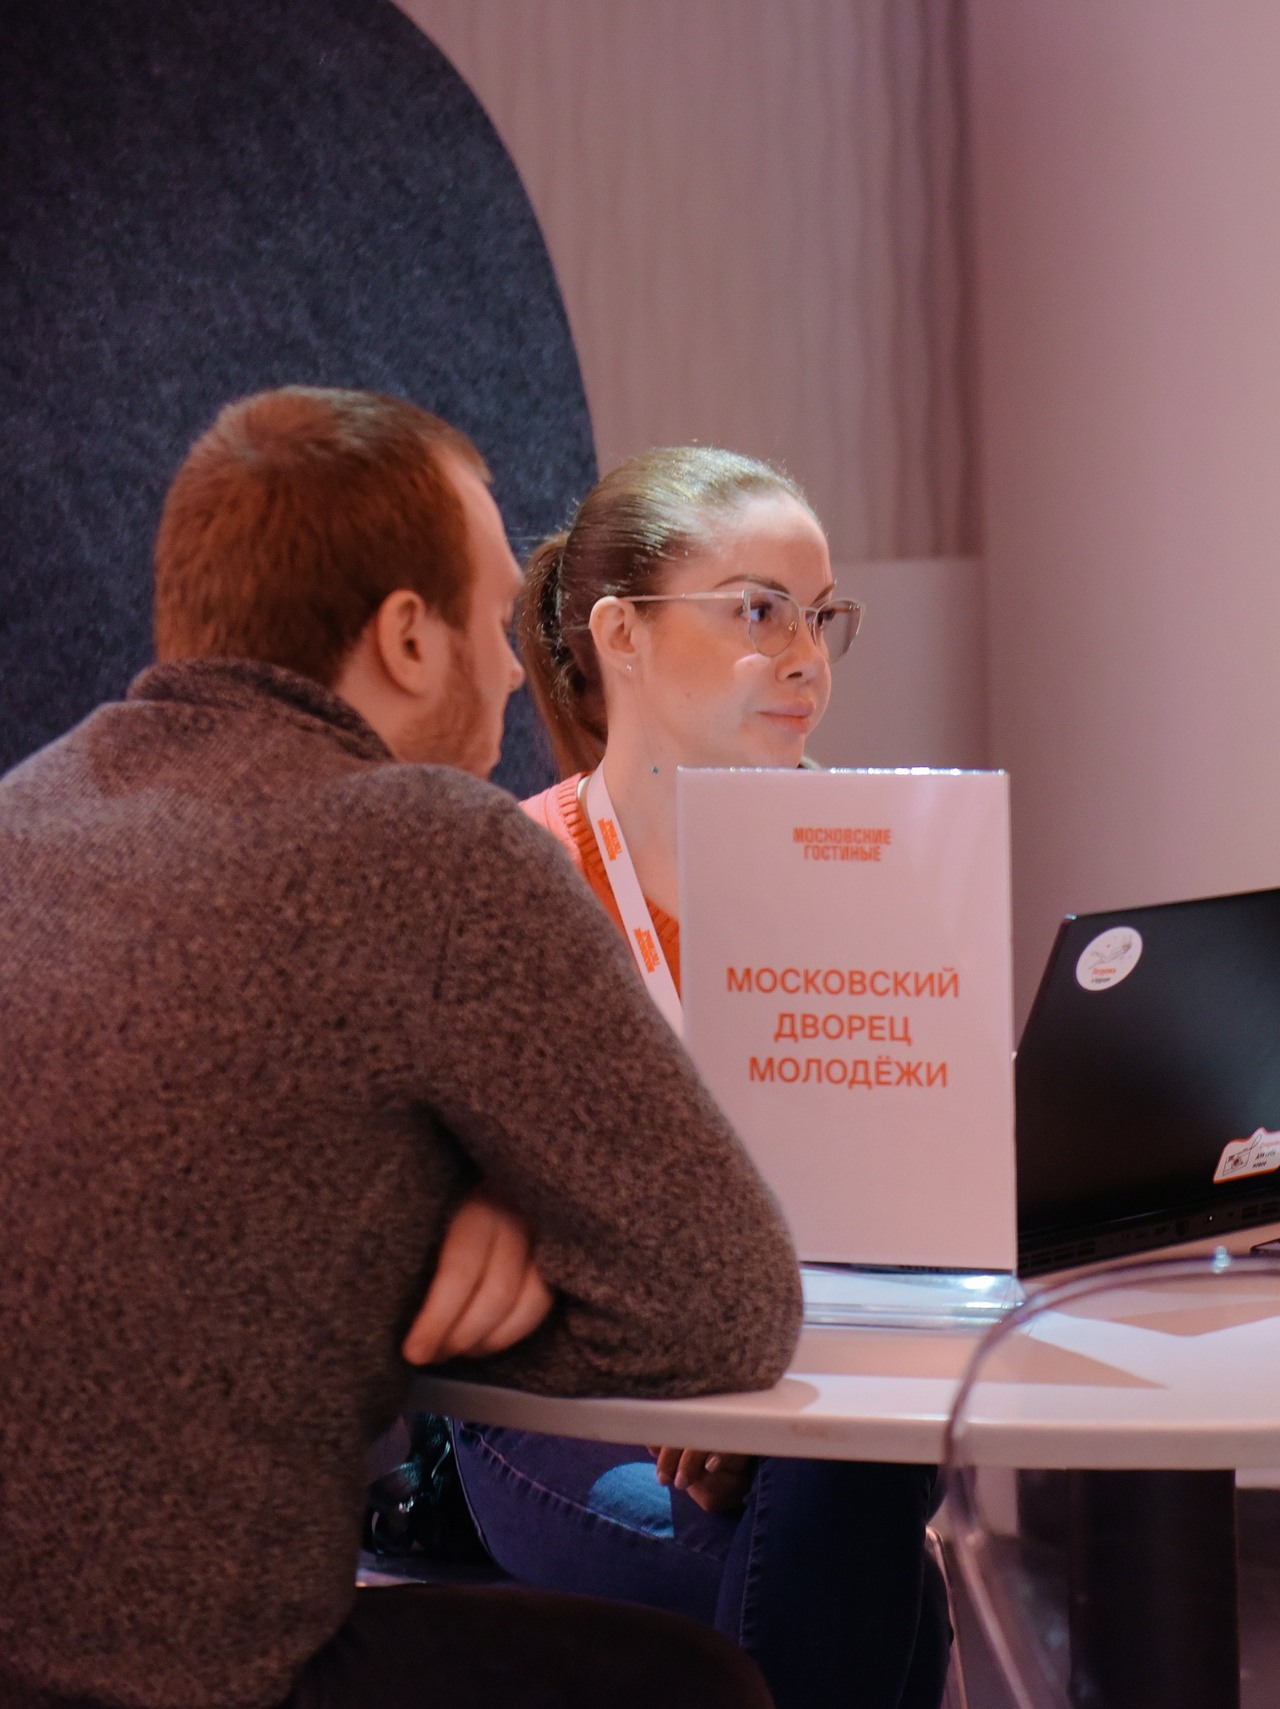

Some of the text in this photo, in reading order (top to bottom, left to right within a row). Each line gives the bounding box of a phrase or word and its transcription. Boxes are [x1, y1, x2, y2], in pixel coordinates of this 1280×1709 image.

[793, 827, 891, 845] МОСКОВСКИЕ
[803, 844, 881, 862] ГОСТИНЫЕ
[726, 966, 960, 998] МОСКОВСКИЙ
[774, 1013, 912, 1046] ДВОРЕЦ
[749, 1055, 949, 1089] МОЛОДЁЖИ
